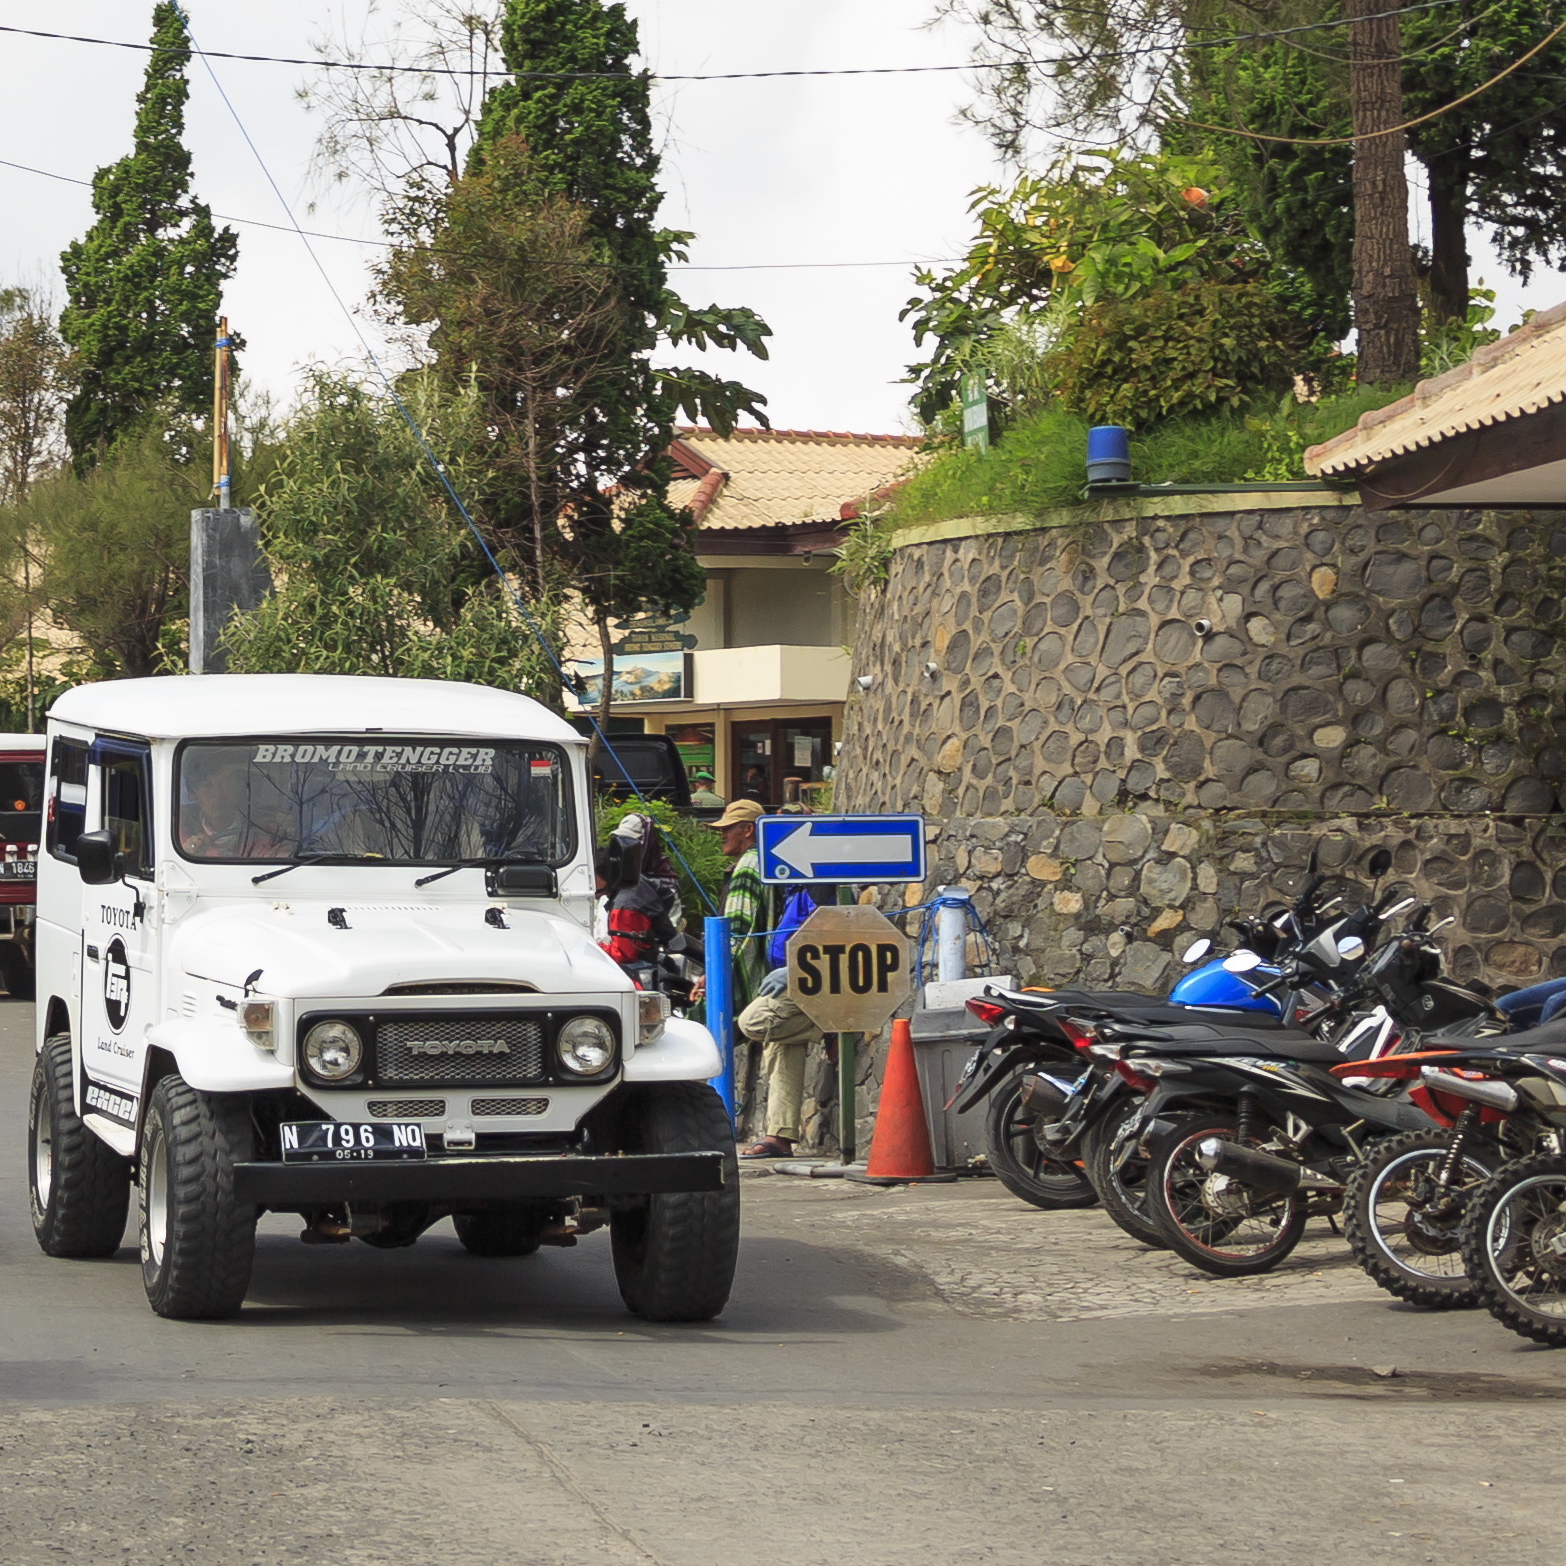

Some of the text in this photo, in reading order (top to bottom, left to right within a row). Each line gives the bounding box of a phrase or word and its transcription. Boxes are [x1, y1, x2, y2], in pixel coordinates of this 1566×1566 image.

[252, 744, 497, 765] BROMO TENGGER
[328, 762, 372, 772] LAND
[376, 763, 444, 773] CRUISER
[100, 904, 137, 931] TOYOTA
[796, 942, 900, 996] STOP
[97, 1036, 135, 1060] Land Cruiser
[406, 1039, 511, 1056] TOYOTA
[284, 1125, 299, 1150] N
[321, 1124, 376, 1149] 796
